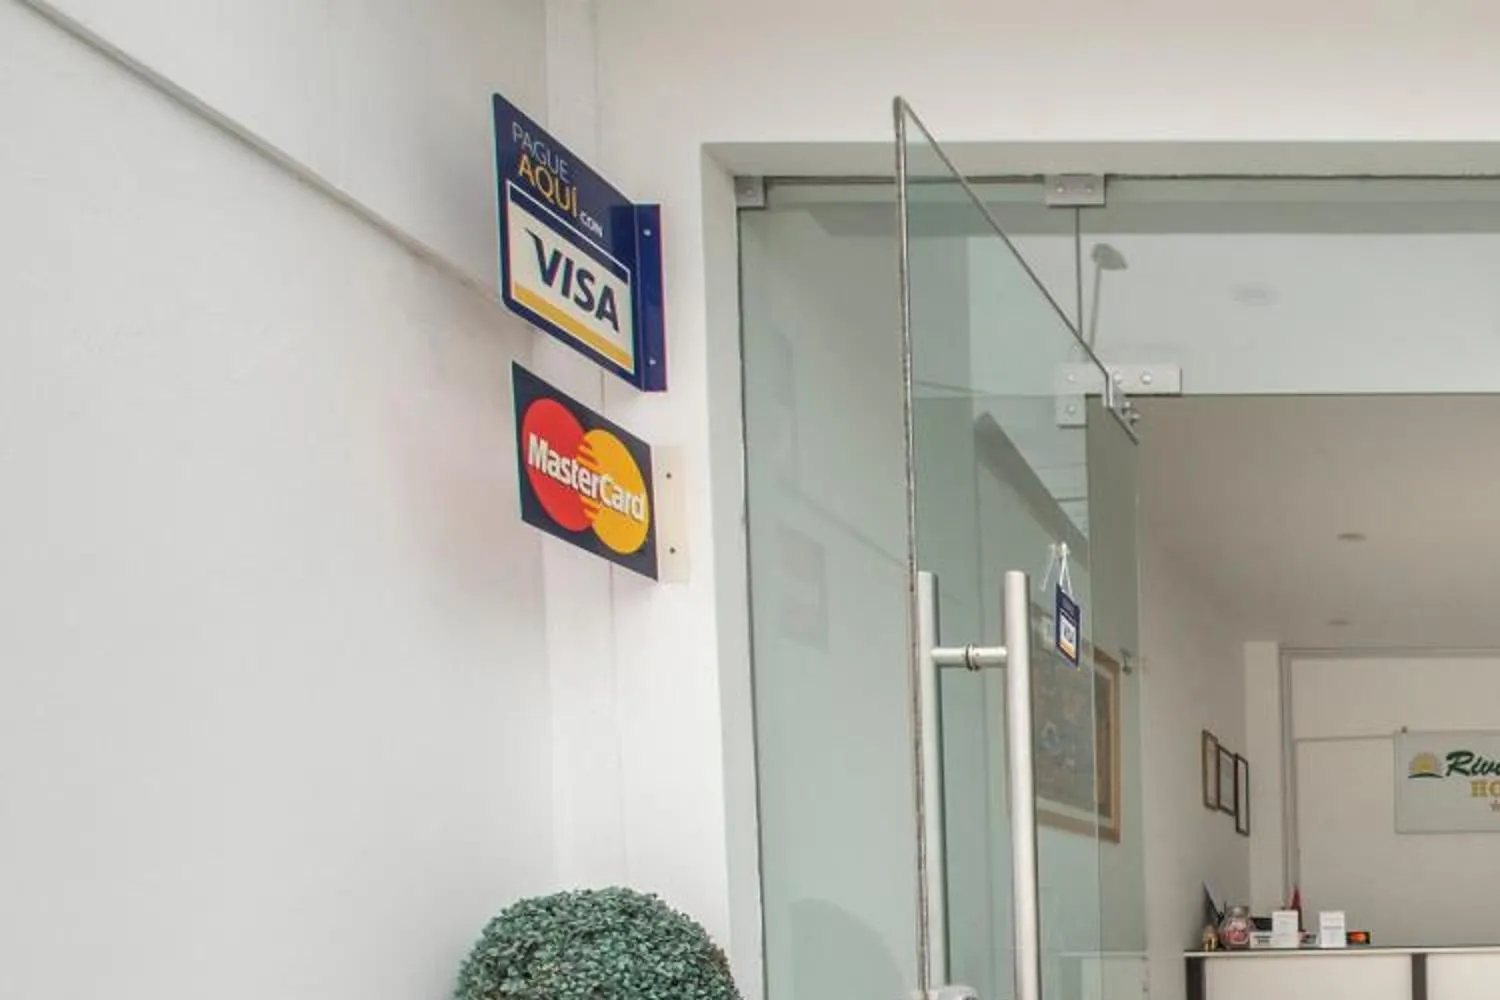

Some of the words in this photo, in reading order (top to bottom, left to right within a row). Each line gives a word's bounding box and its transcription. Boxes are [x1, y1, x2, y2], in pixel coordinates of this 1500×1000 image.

[511, 121, 570, 184] PAGUE
[525, 228, 620, 332] VISA
[528, 433, 646, 523] MasterCard
